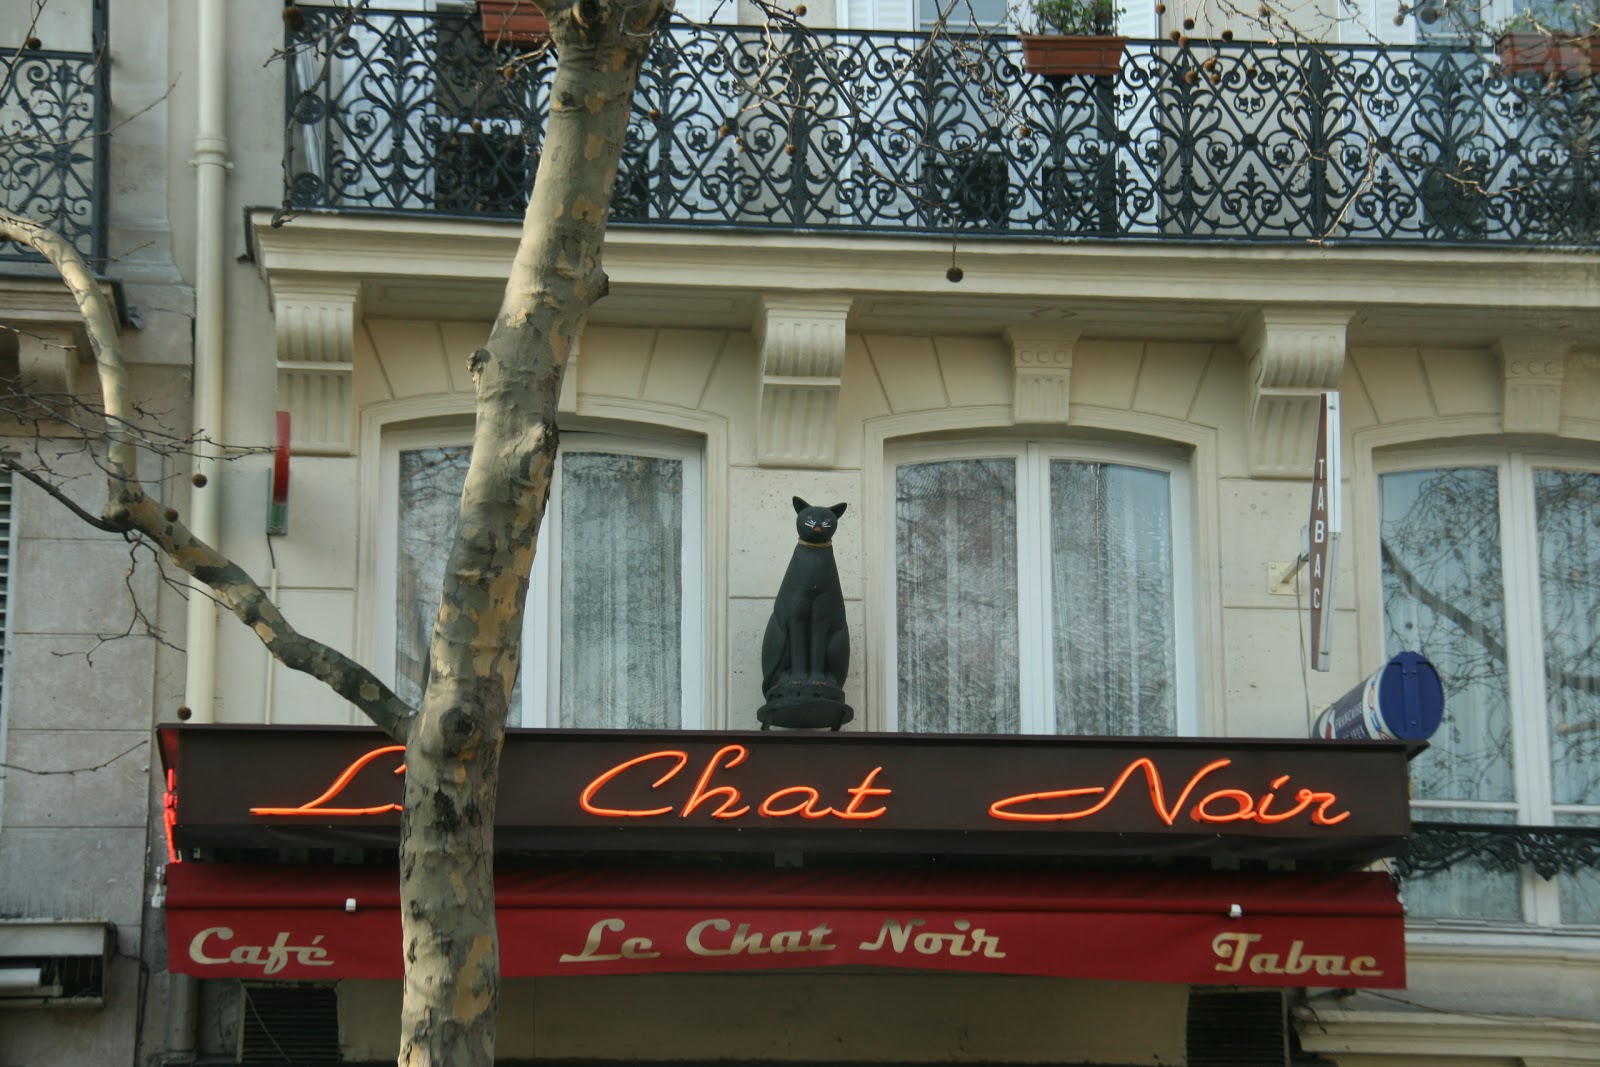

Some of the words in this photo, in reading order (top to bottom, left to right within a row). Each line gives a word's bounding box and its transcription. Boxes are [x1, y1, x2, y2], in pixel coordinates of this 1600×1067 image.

[1313, 458, 1325, 609] TABAC
[579, 744, 892, 819] Chat
[988, 757, 1351, 826] Noir
[189, 926, 335, 975] Café
[558, 917, 661, 962] Le
[685, 918, 837, 956] Chat
[859, 917, 1007, 959] Noir
[1212, 931, 1384, 976] Tabac
